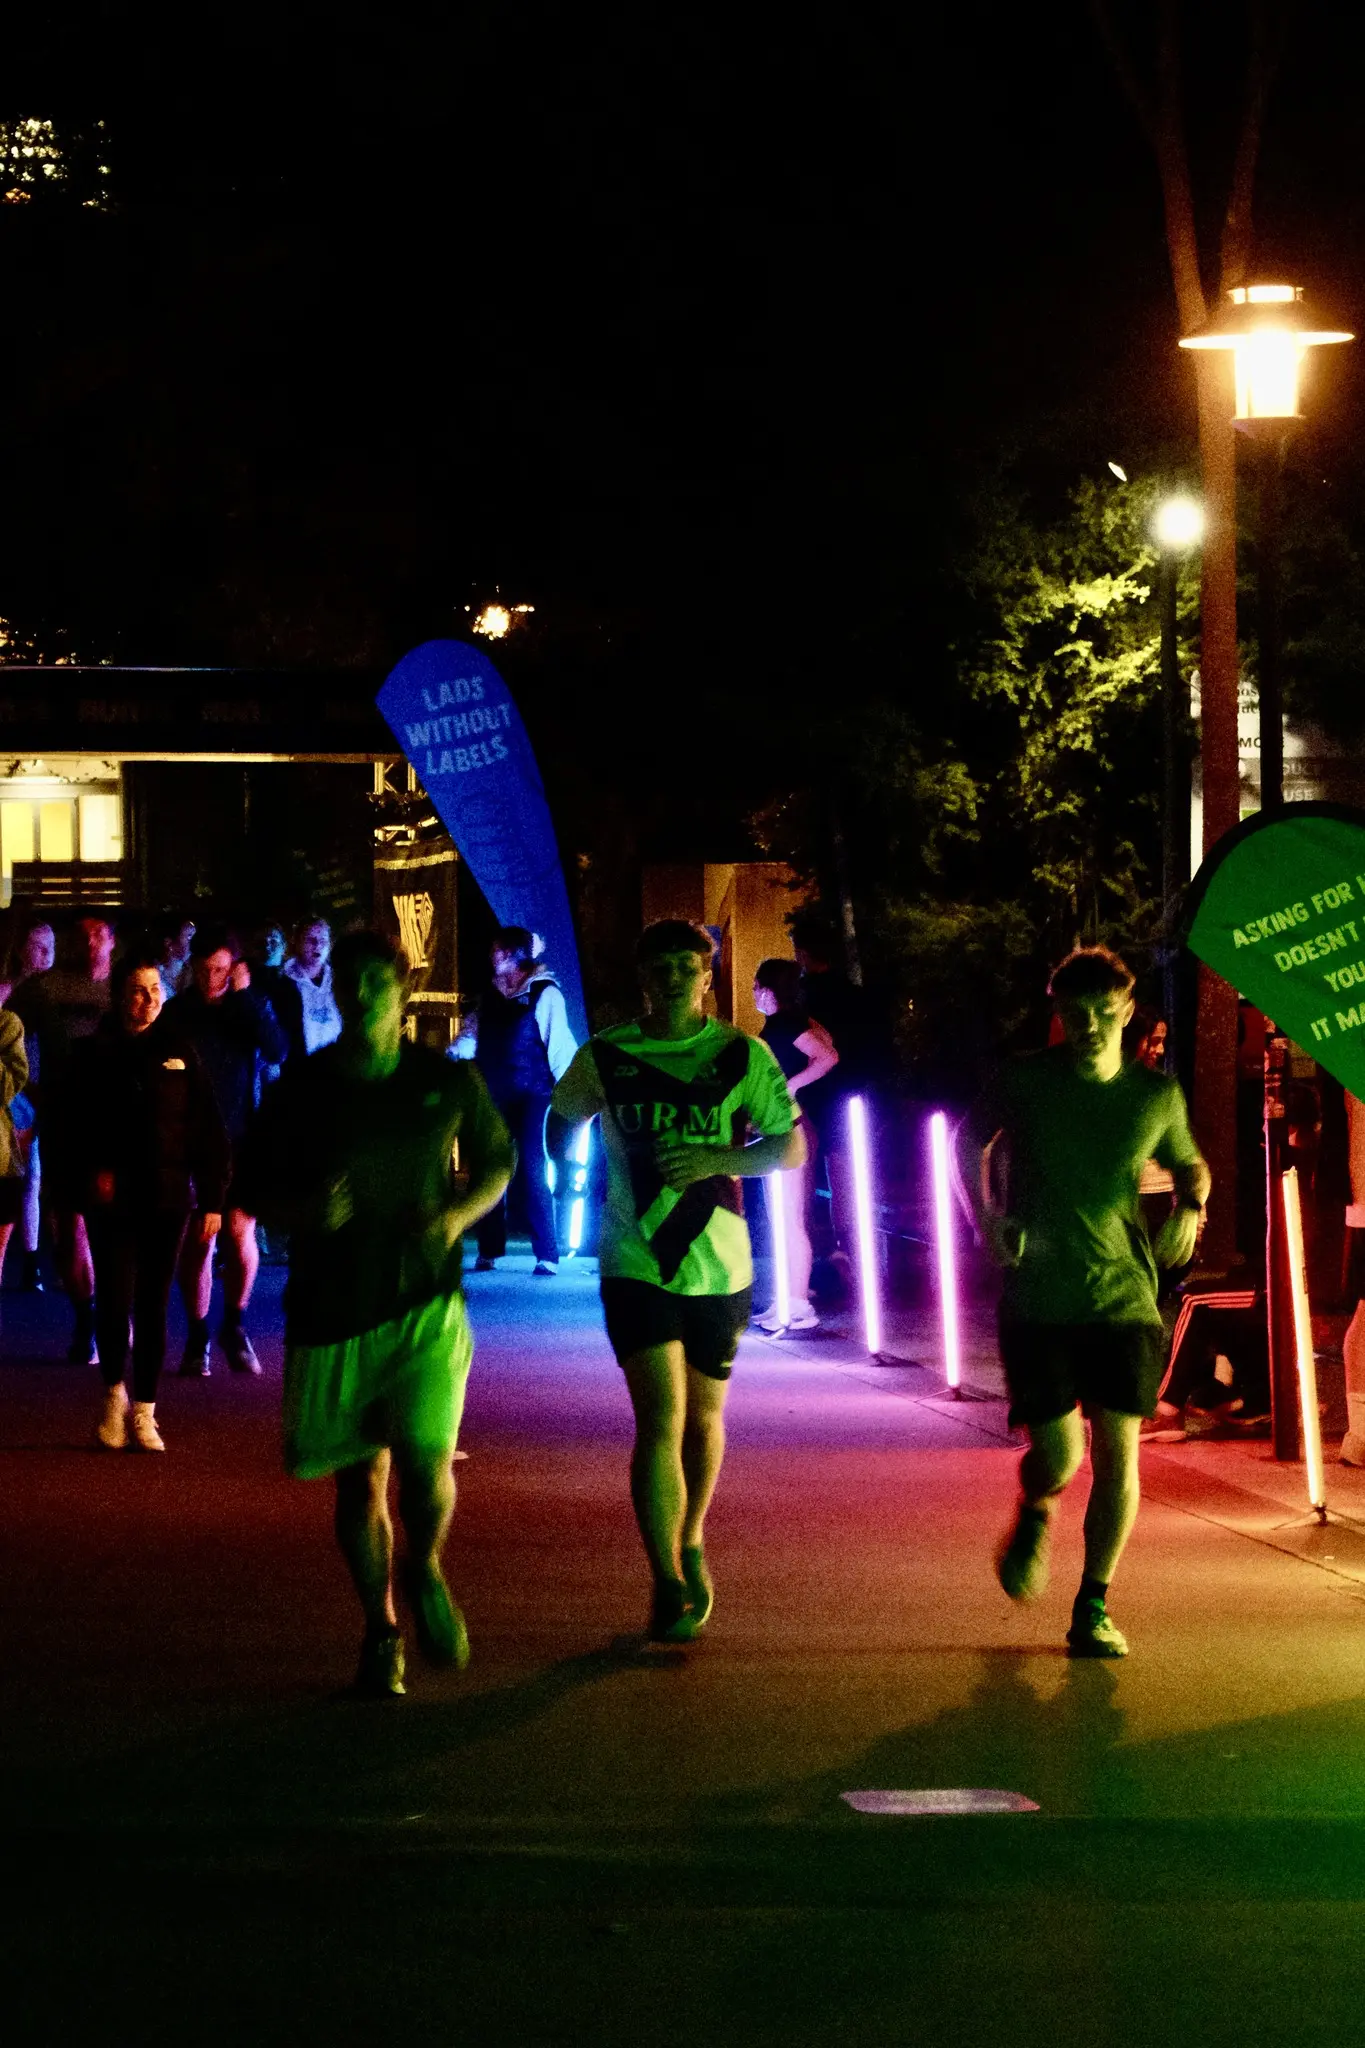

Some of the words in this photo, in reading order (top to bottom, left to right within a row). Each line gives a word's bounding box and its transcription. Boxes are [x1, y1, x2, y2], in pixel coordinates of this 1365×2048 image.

[421, 676, 485, 711] LADS
[405, 703, 511, 747] WITHOUT
[426, 735, 509, 774] LABELS
[1232, 902, 1310, 949] ASKING
[1310, 882, 1355, 915] FOR
[1273, 921, 1360, 972] DOESN'T
[1310, 1017, 1331, 1041] IT
